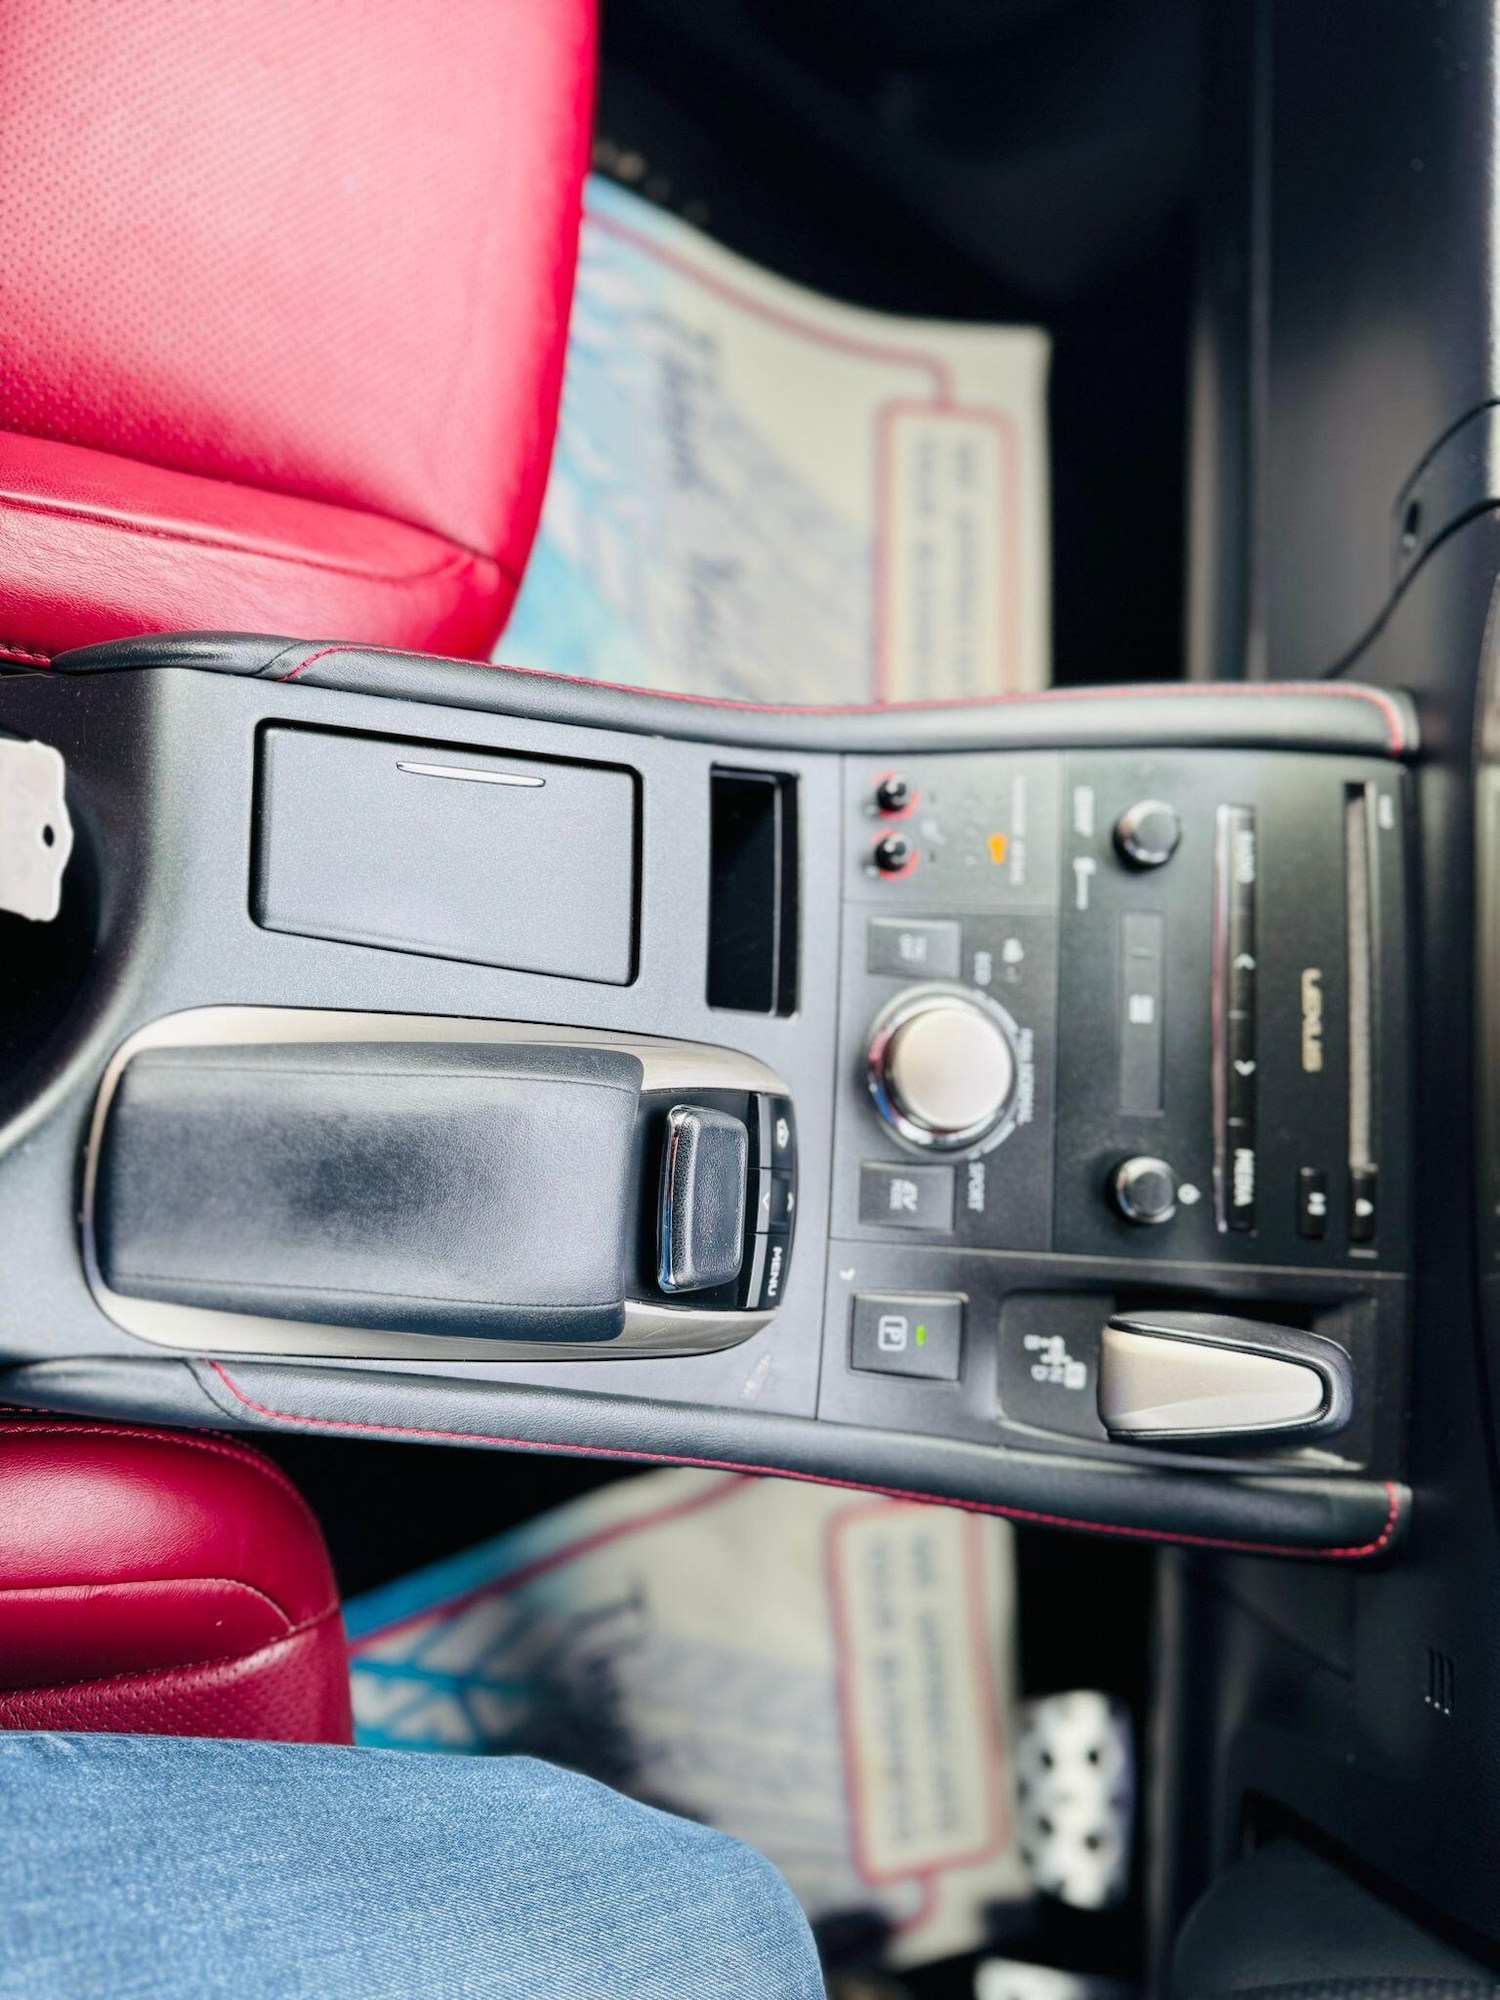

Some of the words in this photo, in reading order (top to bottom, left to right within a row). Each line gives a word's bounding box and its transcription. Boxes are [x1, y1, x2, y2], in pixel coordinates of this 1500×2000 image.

[1300, 967, 1324, 1073] LEXUS
[902, 1180, 918, 1212] EV
[967, 1161, 986, 1212] SPORT
[1232, 1149, 1256, 1207] MEDIA
[766, 1246, 784, 1298] MENU
